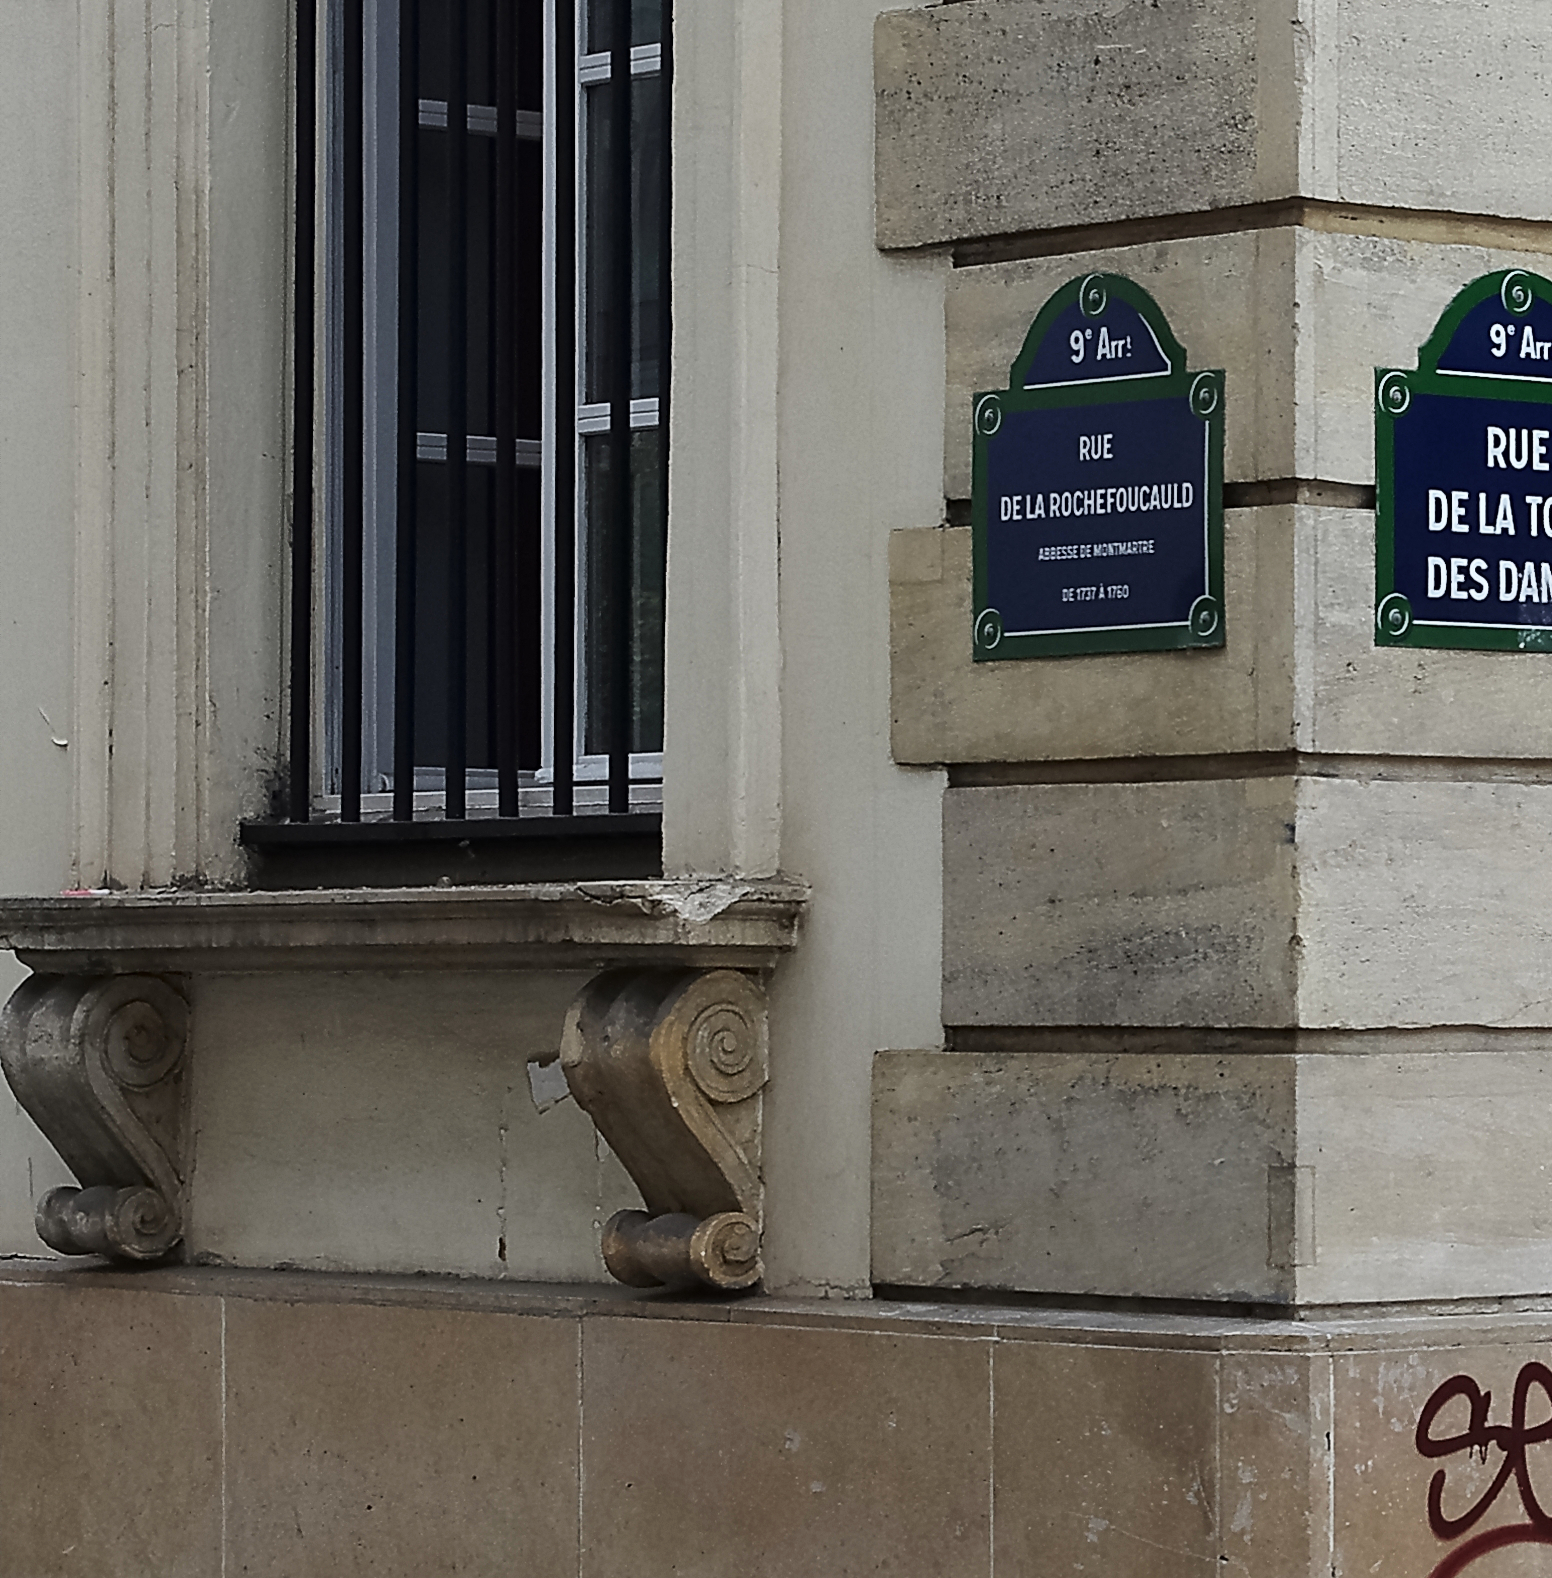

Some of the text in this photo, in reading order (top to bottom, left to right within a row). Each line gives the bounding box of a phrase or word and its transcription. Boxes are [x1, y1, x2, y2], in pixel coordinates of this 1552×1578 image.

[1079, 434, 1114, 461] RUE
[1487, 426, 1550, 471] RUE
[1000, 482, 1194, 521] DE LA ROCHEFOUCAULD
[1428, 489, 1469, 533] DE
[1478, 492, 1516, 536] LA
[1038, 539, 1155, 561] ABBESSE DE MONTMARTRE
[1062, 588, 1074, 602] DE
[1076, 586, 1096, 601] 1737
[1098, 583, 1105, 599] À
[1427, 555, 1489, 601] DES
